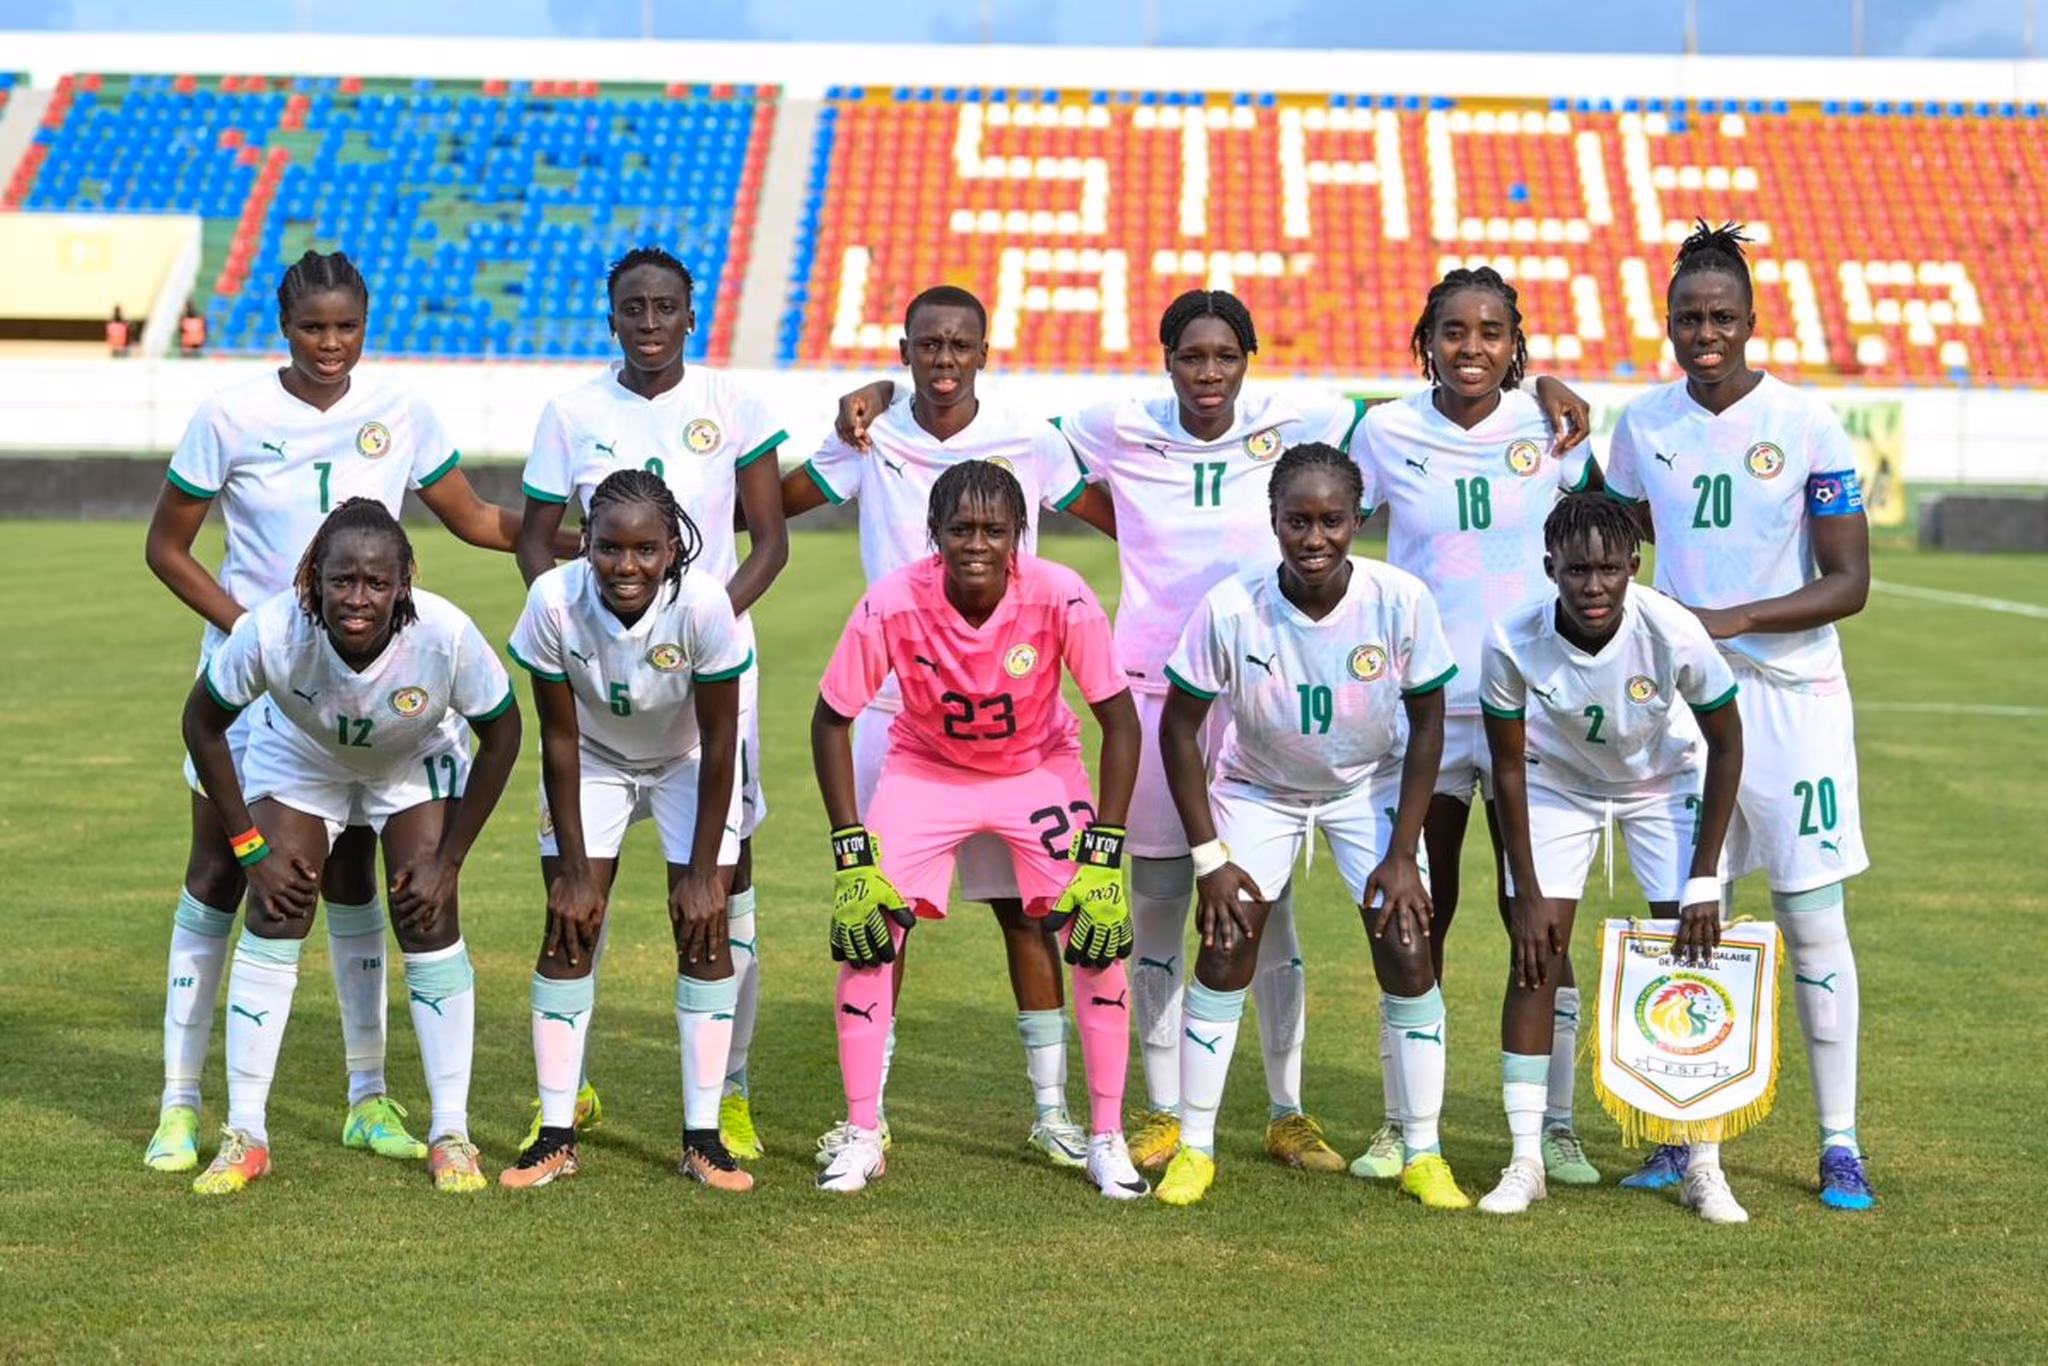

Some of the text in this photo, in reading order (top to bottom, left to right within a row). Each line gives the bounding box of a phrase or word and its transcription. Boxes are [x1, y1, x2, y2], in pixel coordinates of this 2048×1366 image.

[951, 103, 1771, 244] STADE
[830, 245, 1315, 351] LAT
[313, 461, 332, 514] 7
[1192, 461, 1228, 507] 17
[1454, 475, 1492, 532] 18
[1691, 473, 1732, 529] 20
[609, 681, 632, 717] 5
[941, 690, 1017, 741] 23
[1296, 683, 1333, 735] 19
[1583, 704, 1606, 744] 2
[336, 713, 374, 749] 12
[1793, 776, 1837, 837] 20
